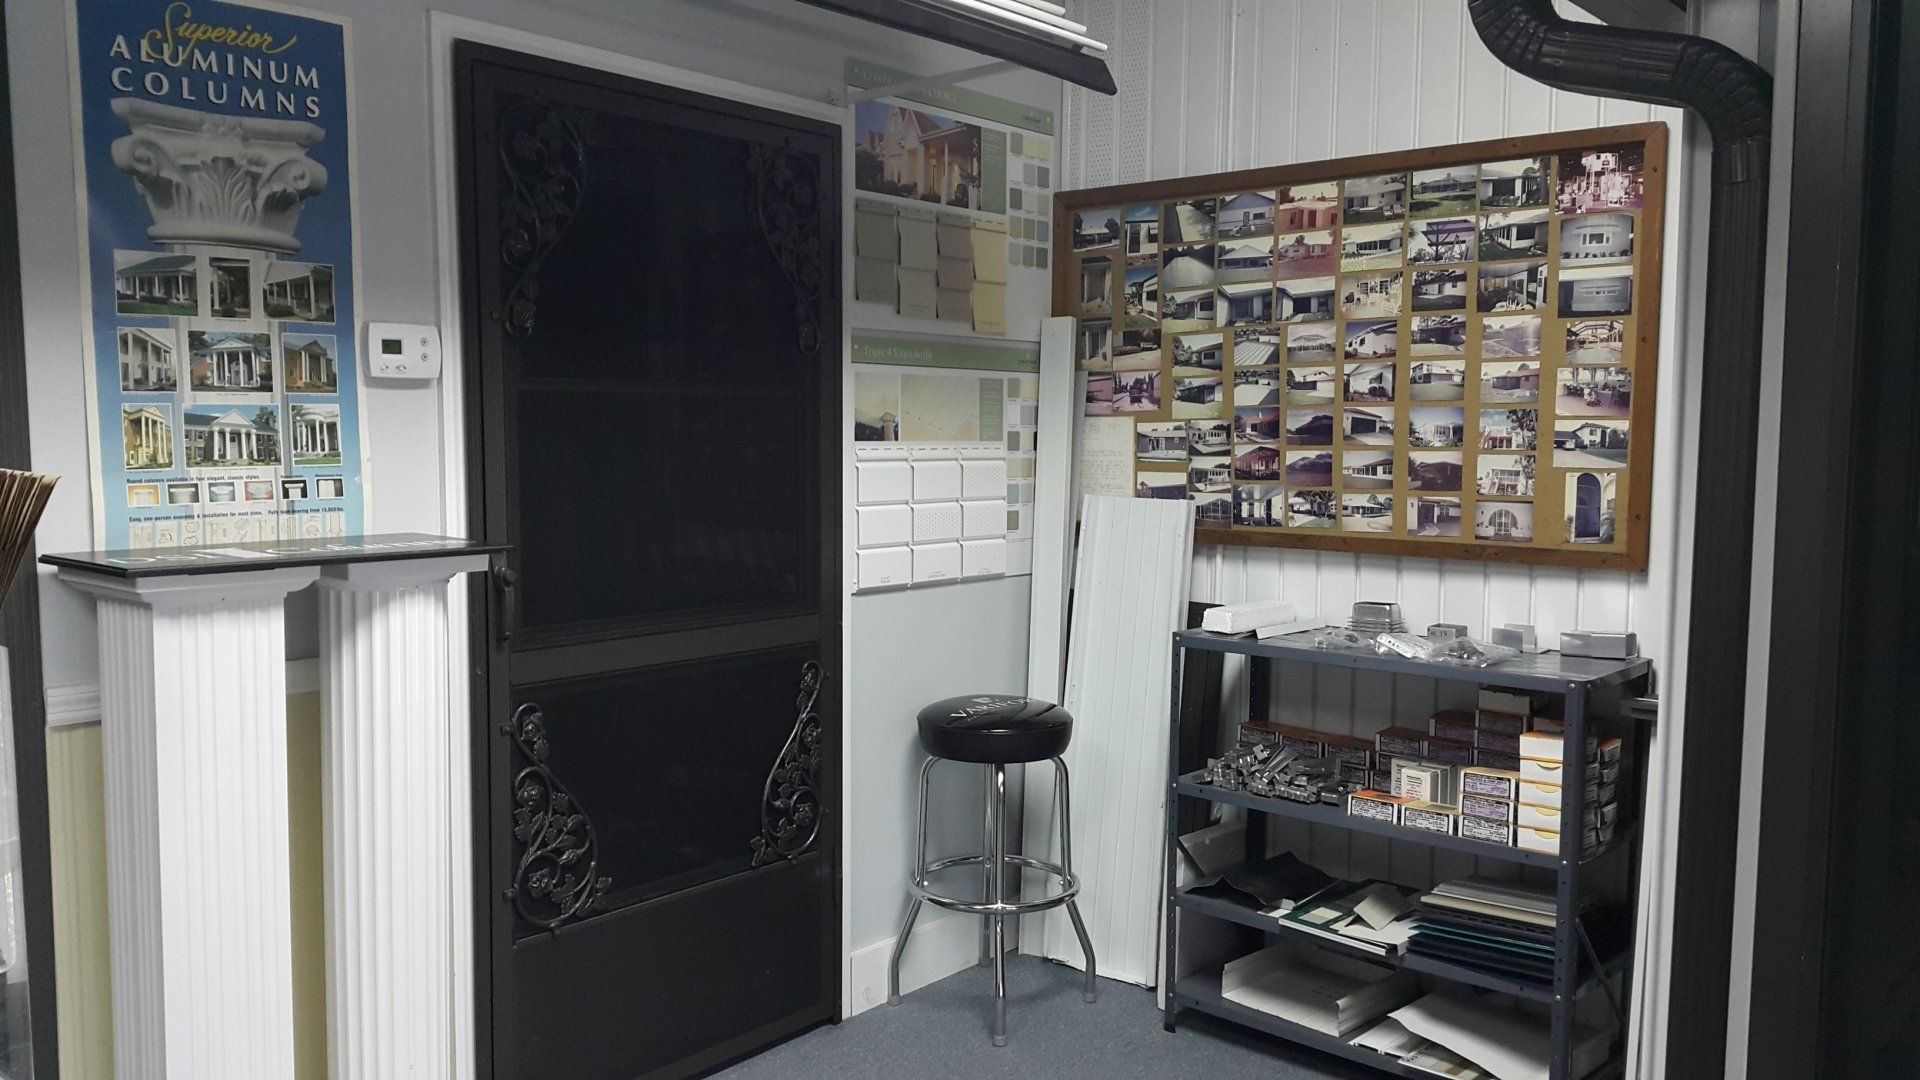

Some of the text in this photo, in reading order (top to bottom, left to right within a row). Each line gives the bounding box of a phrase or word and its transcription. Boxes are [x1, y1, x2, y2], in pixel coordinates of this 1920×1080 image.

[143, 1, 299, 63] Superior
[109, 34, 321, 91] ALUMINUM
[110, 67, 321, 119] COLUMNS
[864, 345, 885, 359] Triple
[143, 514, 172, 522] one-person
